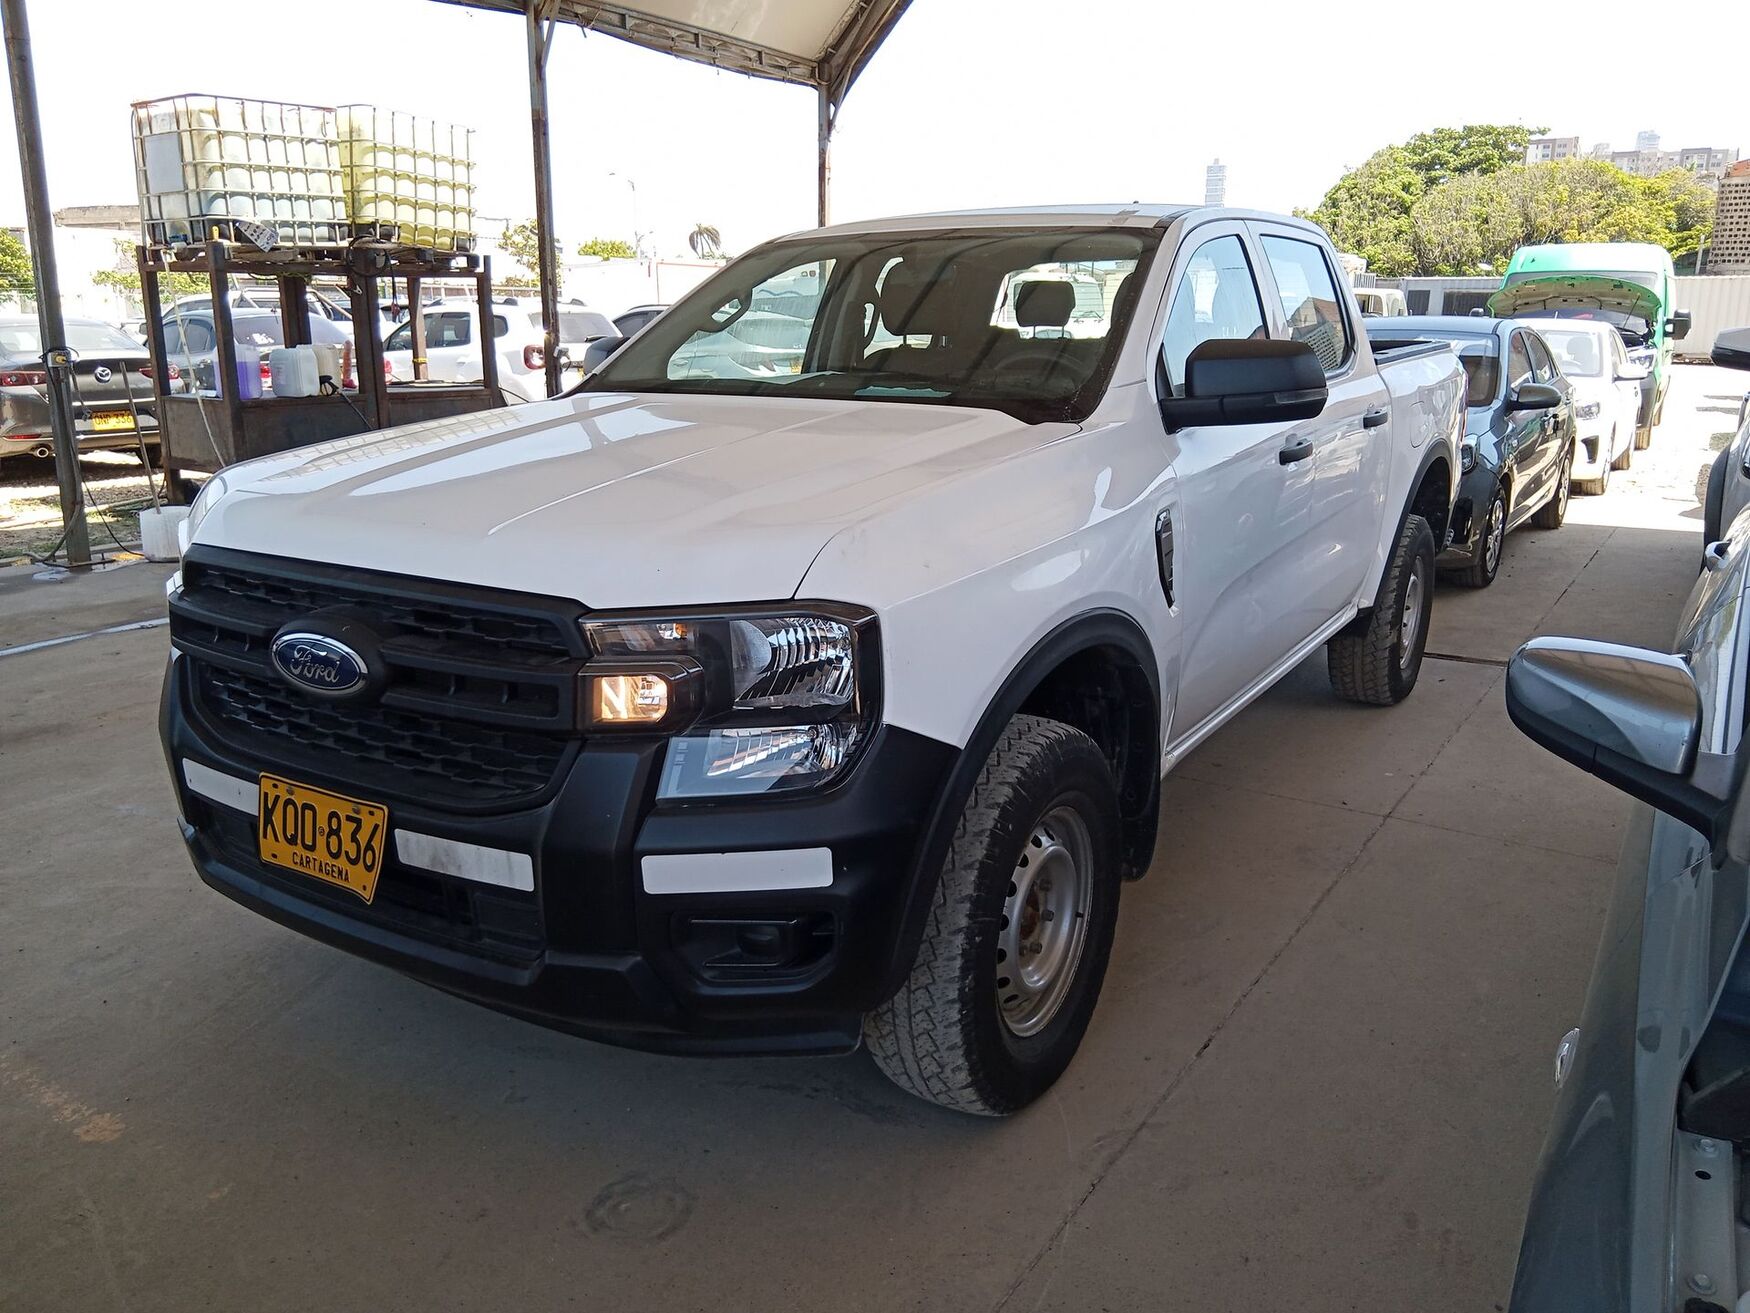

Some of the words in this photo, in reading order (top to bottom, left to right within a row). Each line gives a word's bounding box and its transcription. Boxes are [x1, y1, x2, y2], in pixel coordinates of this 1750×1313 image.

[290, 644, 341, 683] Ford
[325, 810, 380, 873] 836
[292, 851, 351, 884] CARTAGENA
